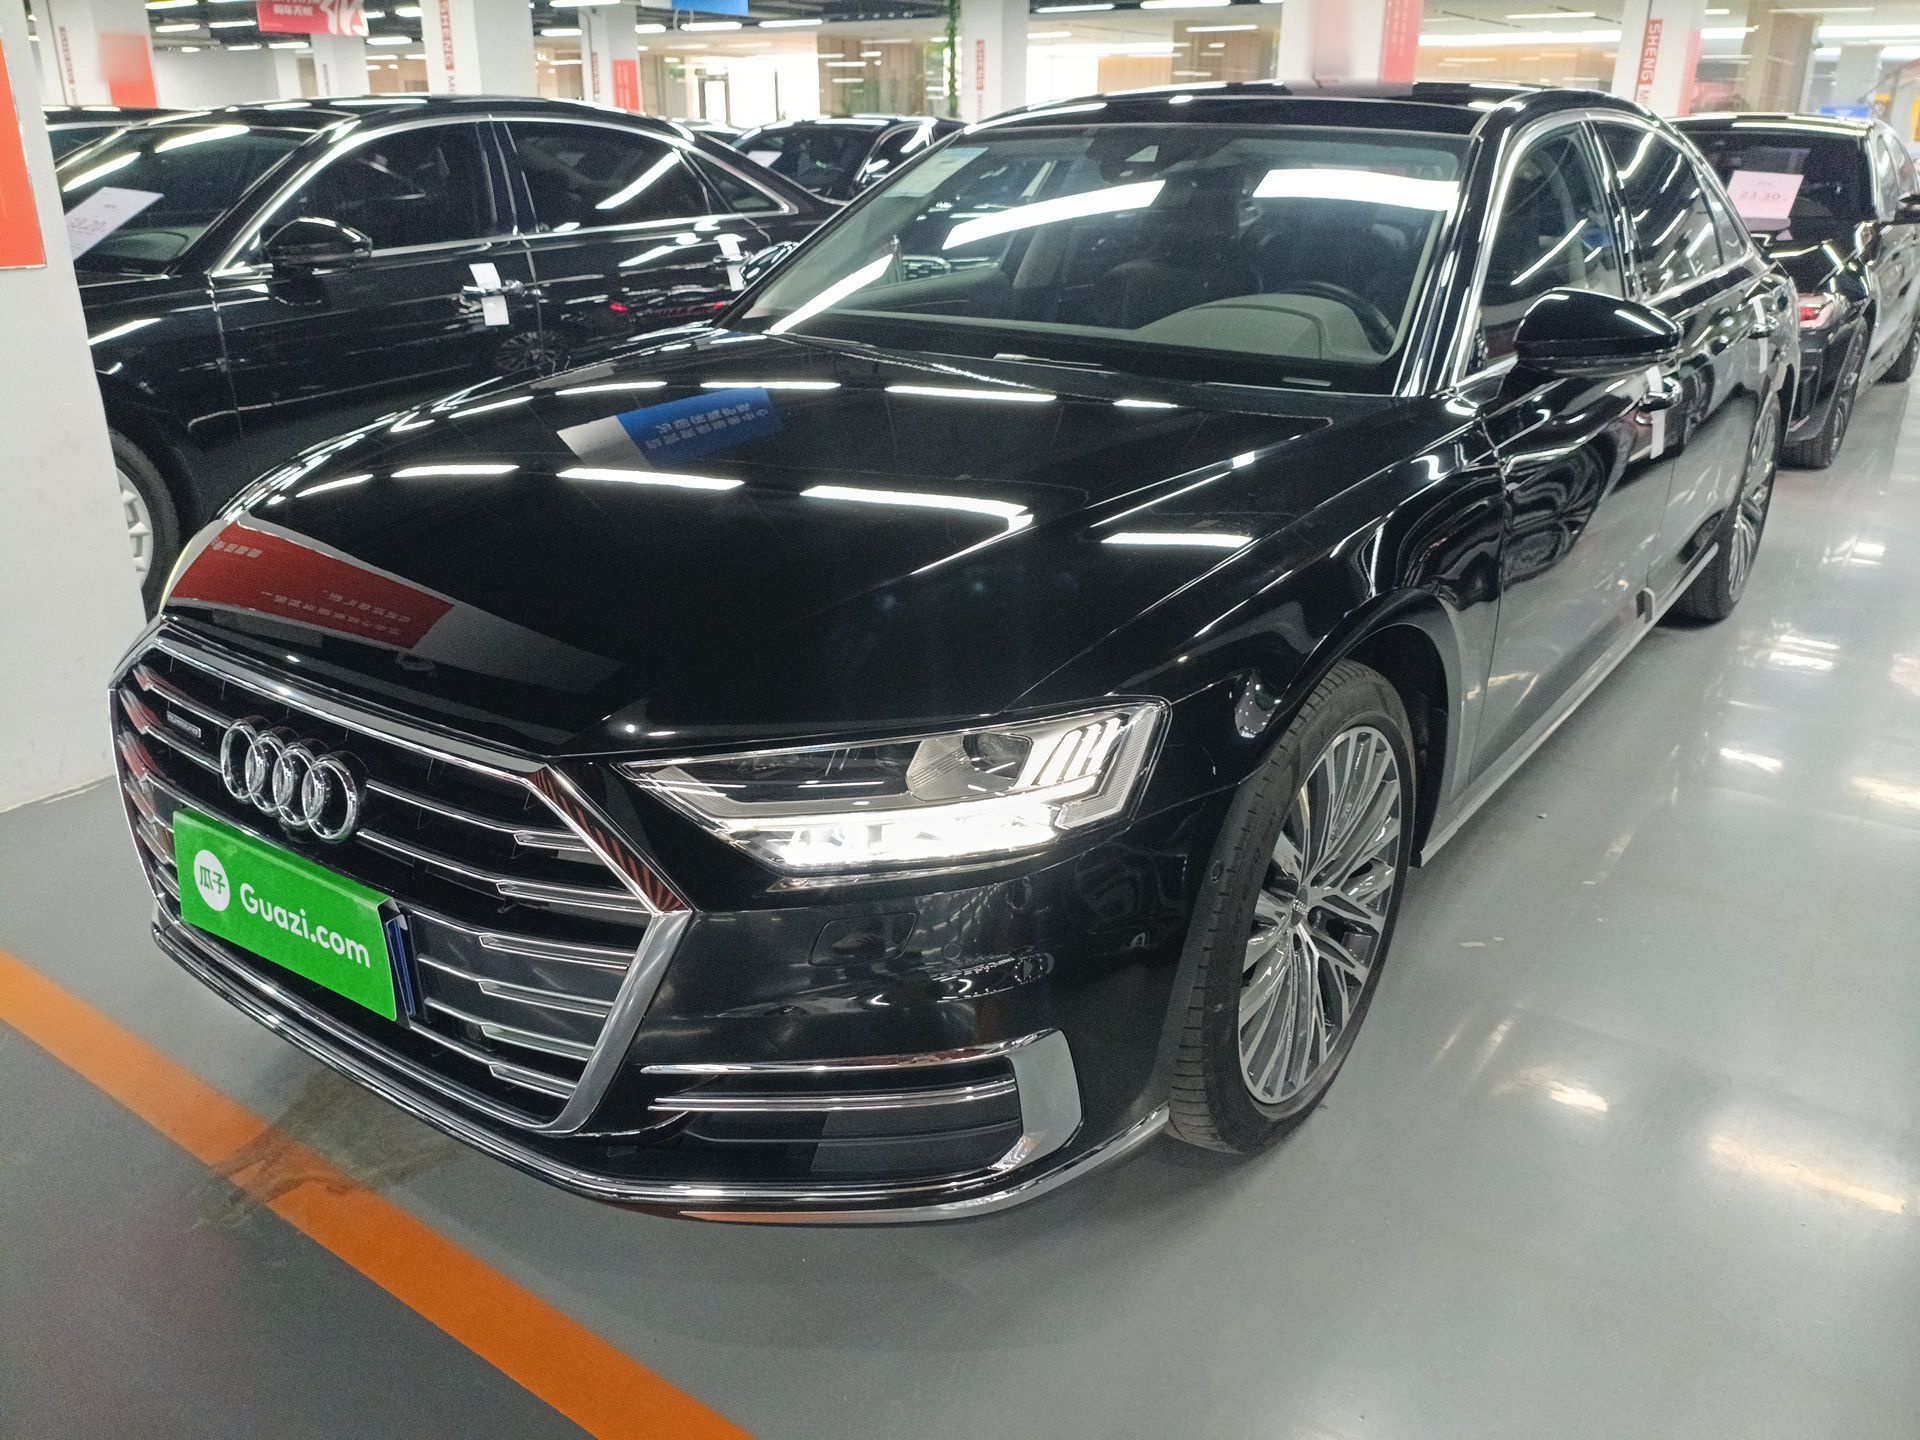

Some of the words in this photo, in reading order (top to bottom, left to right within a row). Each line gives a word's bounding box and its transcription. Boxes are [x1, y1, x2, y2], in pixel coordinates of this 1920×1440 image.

[440, 1, 454, 66] SHENG
[1641, 23, 1661, 81] SHENG
[199, 865, 226, 895] 瓜子
[240, 883, 371, 968] Guazi.com
